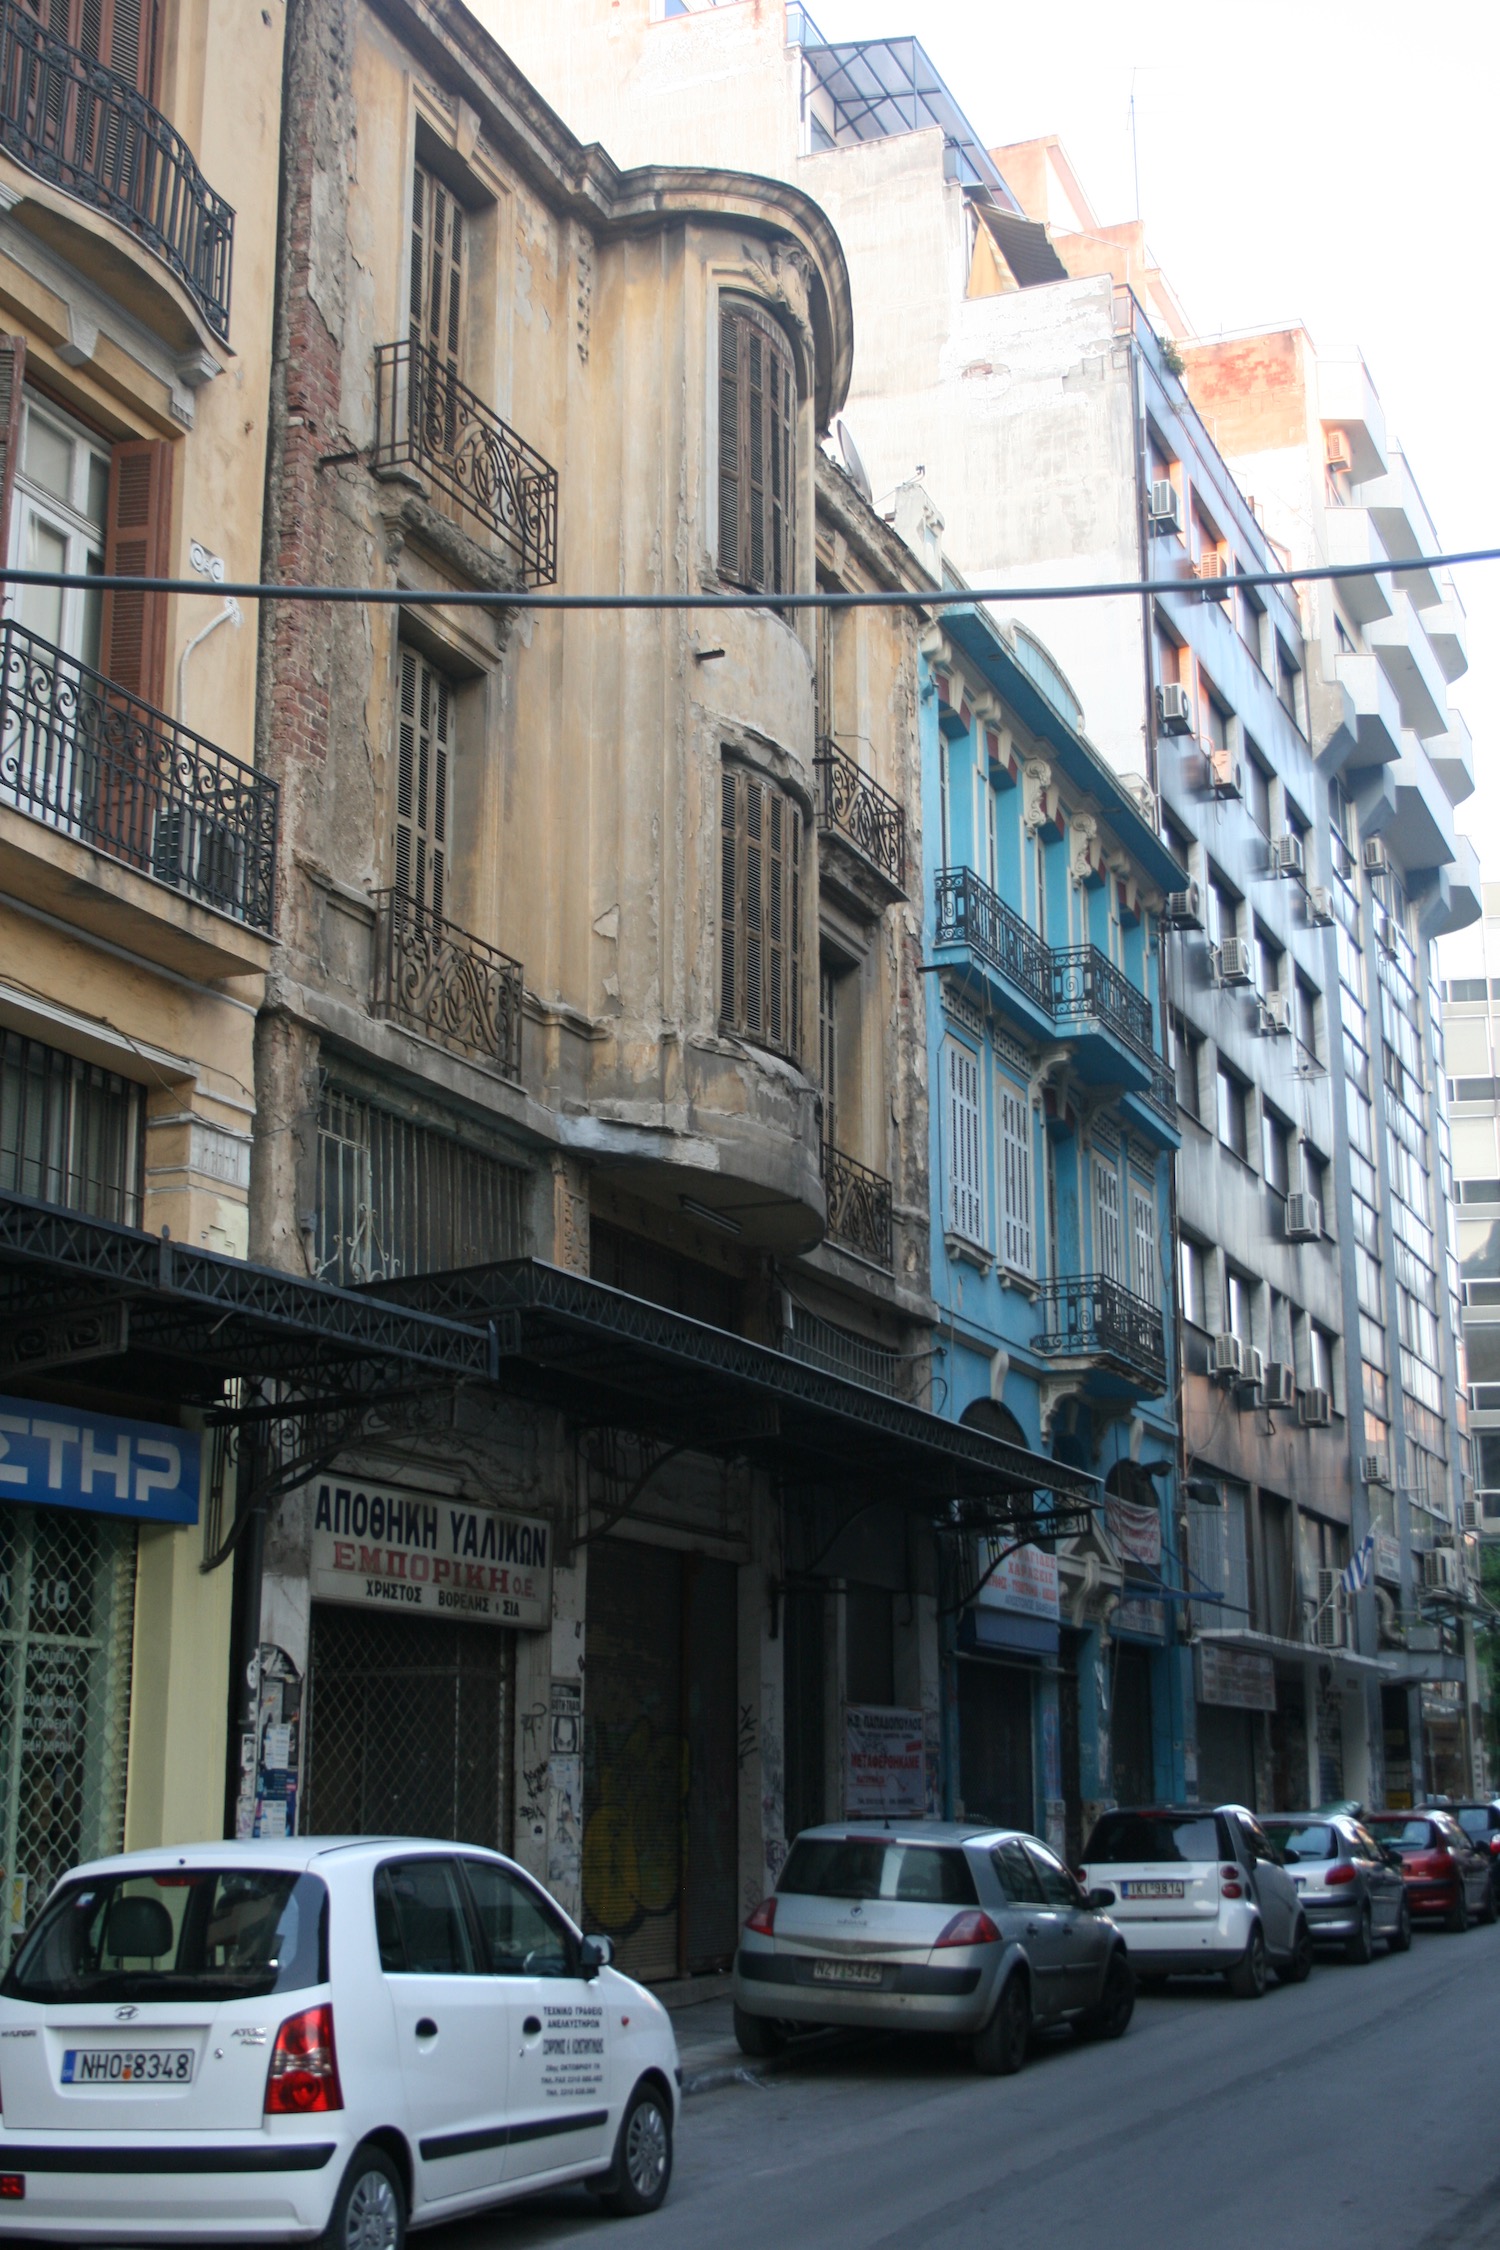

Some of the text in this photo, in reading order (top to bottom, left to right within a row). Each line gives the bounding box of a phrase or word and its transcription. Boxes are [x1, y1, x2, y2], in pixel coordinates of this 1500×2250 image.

[315, 1484, 547, 1568] ΑΠΟΘΗΚΗ ΥΑΛΙΚΩΝ
[333, 1541, 537, 1598] ΕΜΠΟΡΙΚΗ Ο.Ε.
[366, 1579, 422, 1604] ΧΡΗΣΤΟΣ
[502, 1600, 520, 1617] ΣΙΑ
